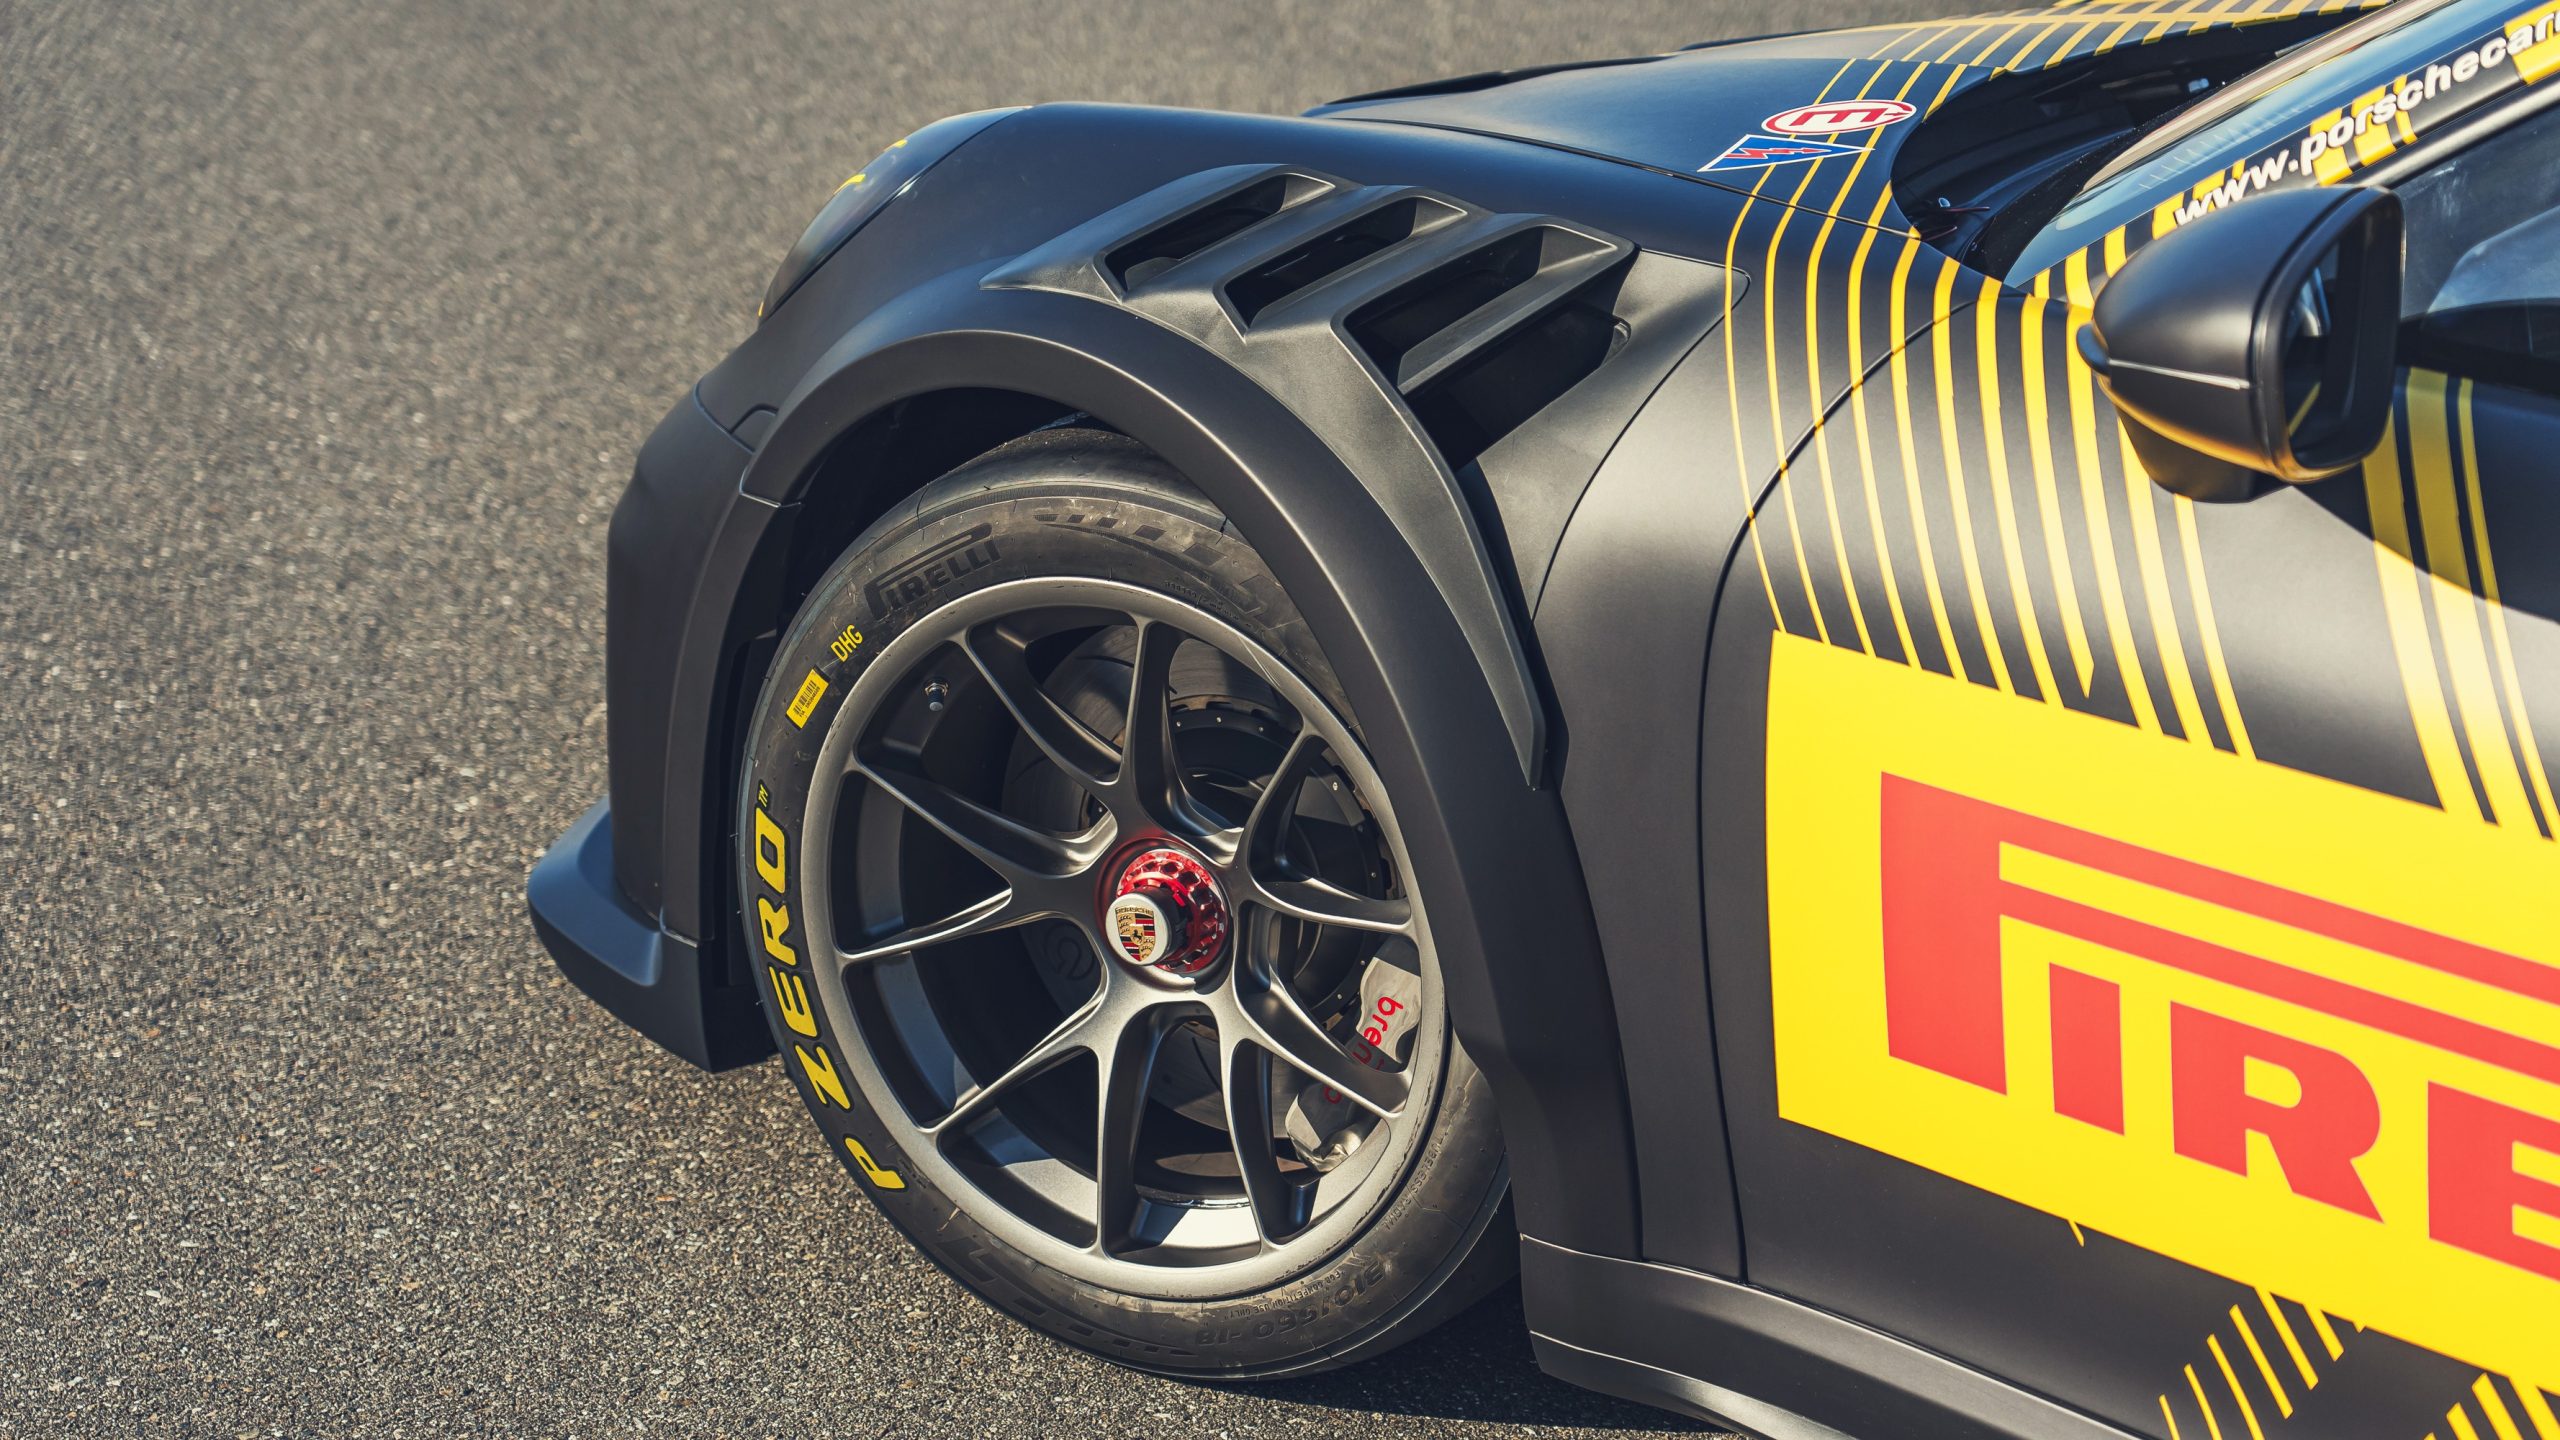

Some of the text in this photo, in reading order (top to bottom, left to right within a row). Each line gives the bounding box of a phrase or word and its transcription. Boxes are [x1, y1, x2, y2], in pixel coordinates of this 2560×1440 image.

[2174, 9, 2560, 226] www.porschecar
[863, 522, 1001, 620] PIRELLI
[830, 624, 863, 662] DHG
[755, 807, 851, 1111] ZERO
[845, 1137, 905, 1190] P
